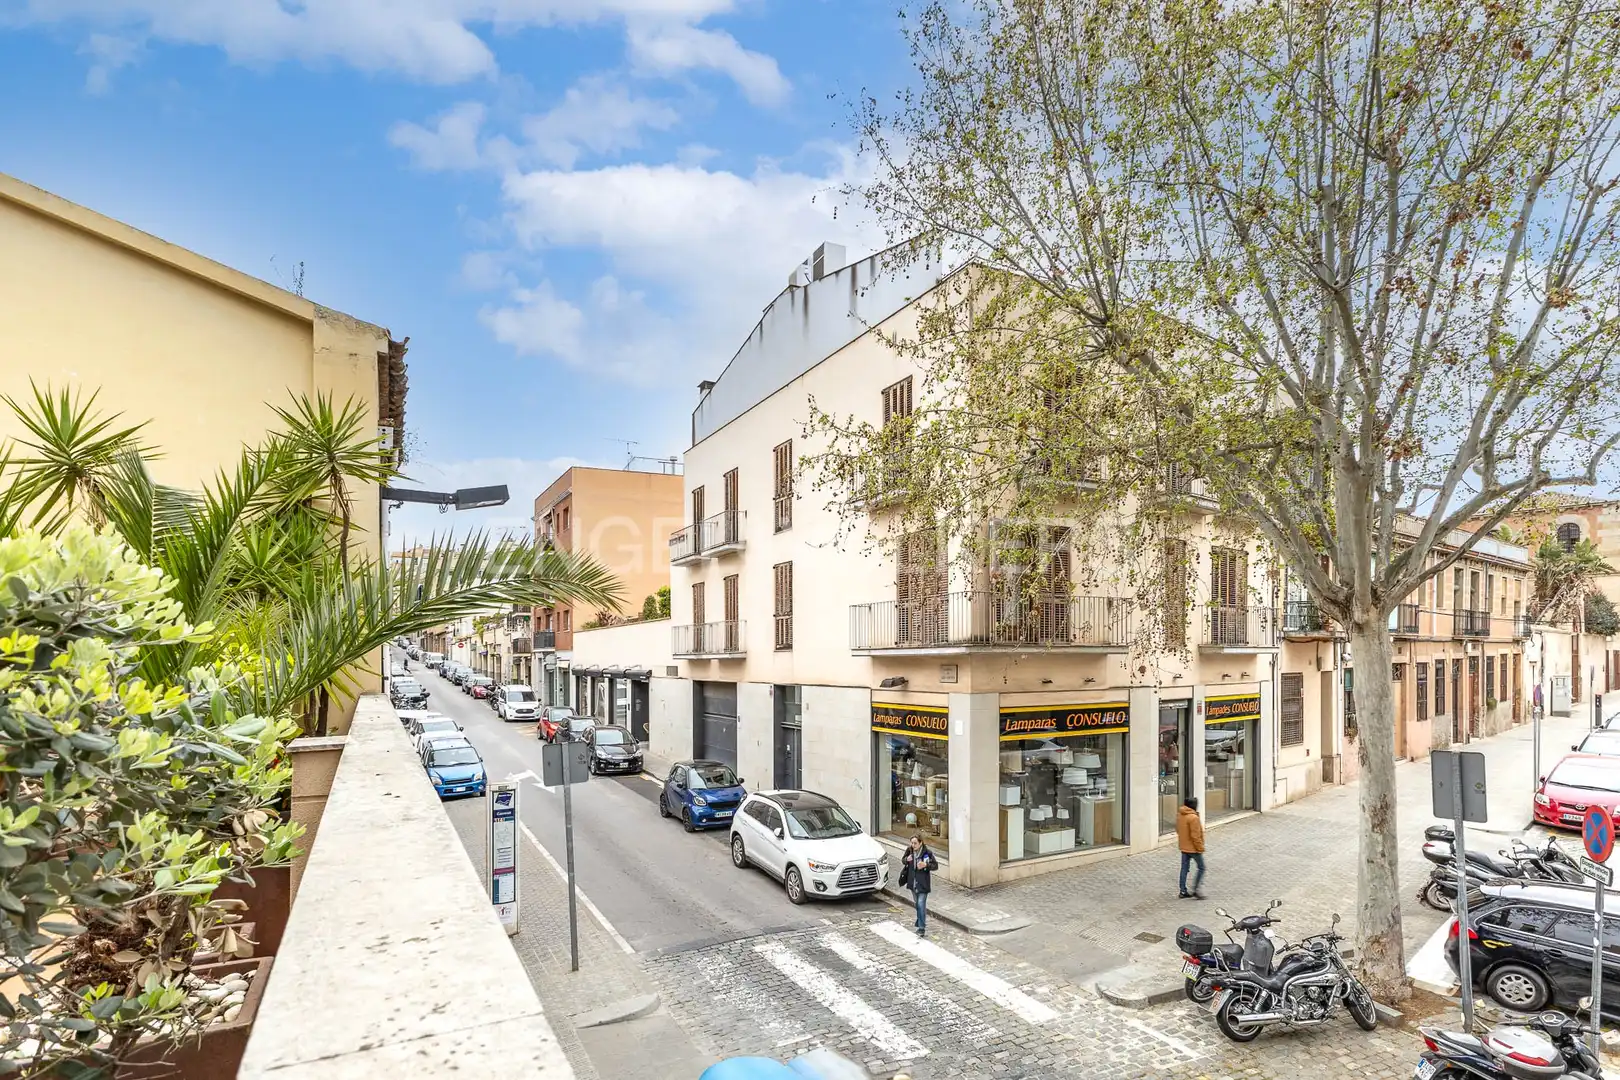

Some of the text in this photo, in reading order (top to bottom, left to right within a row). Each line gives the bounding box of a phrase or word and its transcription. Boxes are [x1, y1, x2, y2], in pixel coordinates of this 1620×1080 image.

[1231, 701, 1260, 713] CONSUELO
[905, 714, 948, 730] CONSUELO
[1005, 711, 1126, 731] Lamparas CONSUELO
